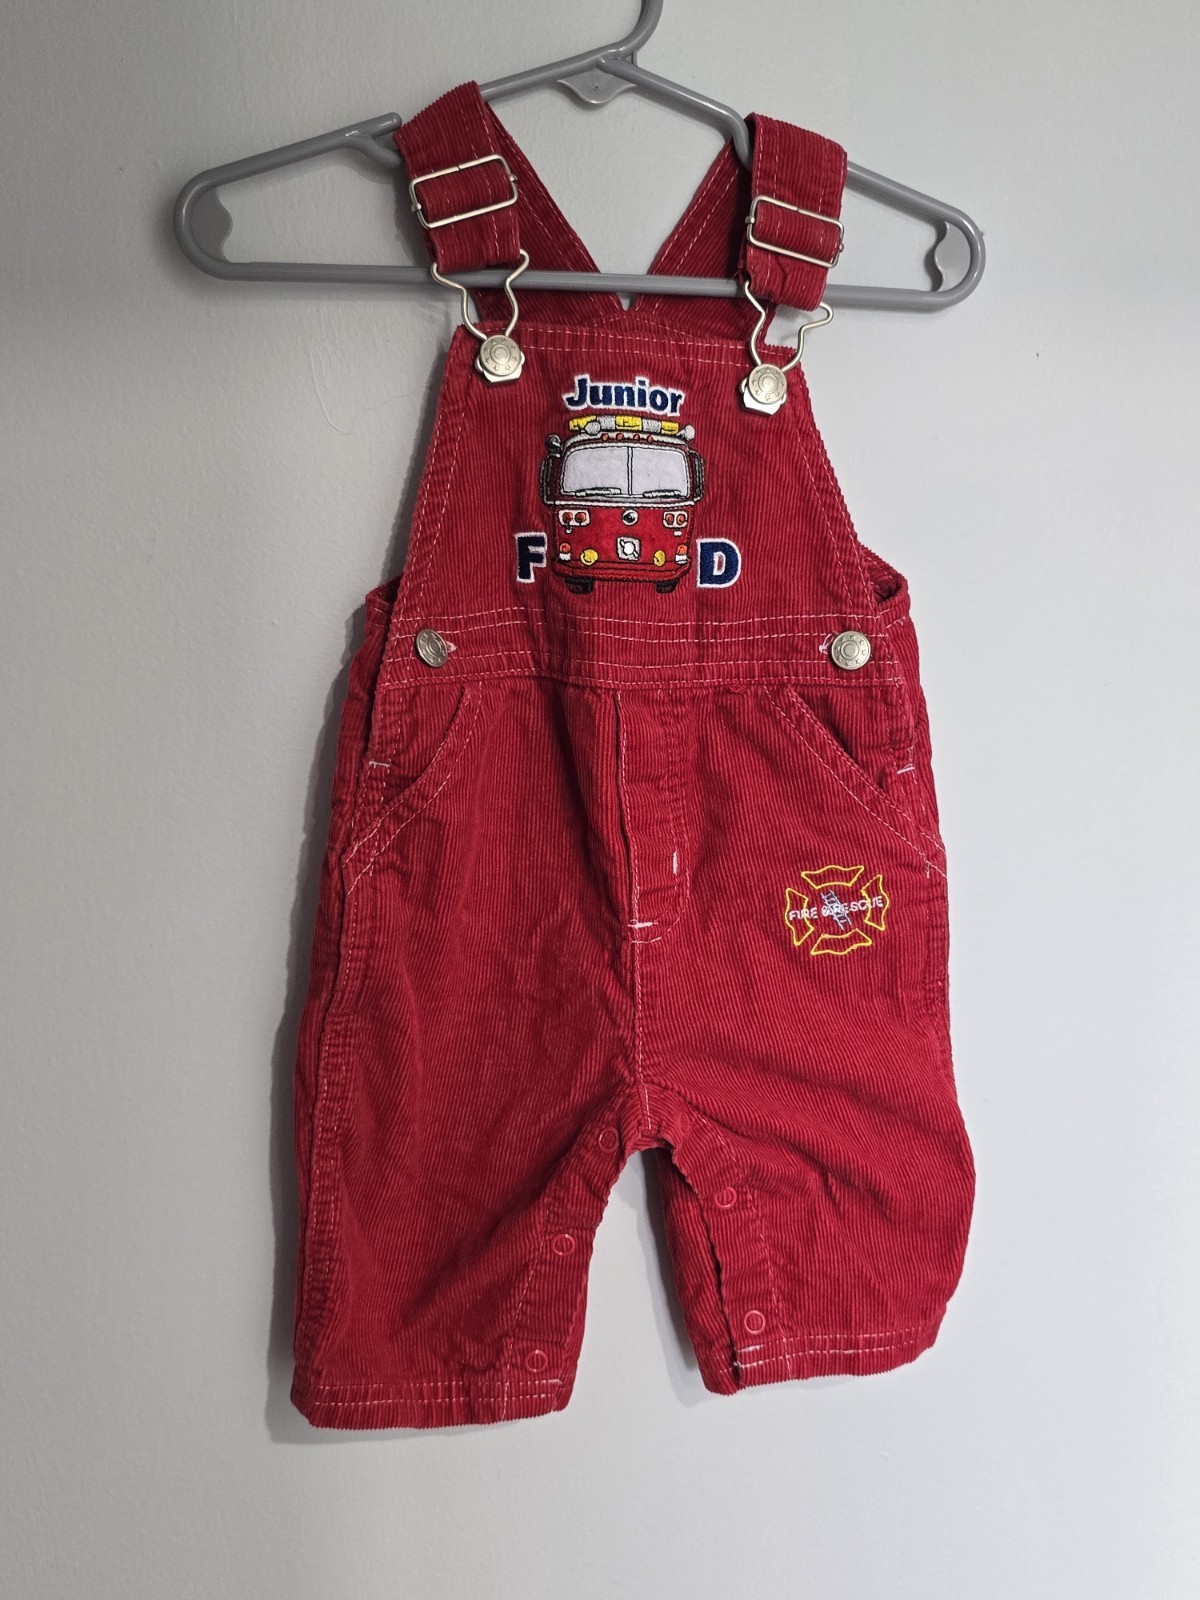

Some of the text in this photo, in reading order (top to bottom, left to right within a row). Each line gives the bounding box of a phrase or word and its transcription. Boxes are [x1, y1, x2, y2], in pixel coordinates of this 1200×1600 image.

[563, 375, 685, 415] Junior
[515, 532, 741, 588] F D
[789, 907, 818, 920] FIRE
[833, 896, 883, 914] RESCUE
